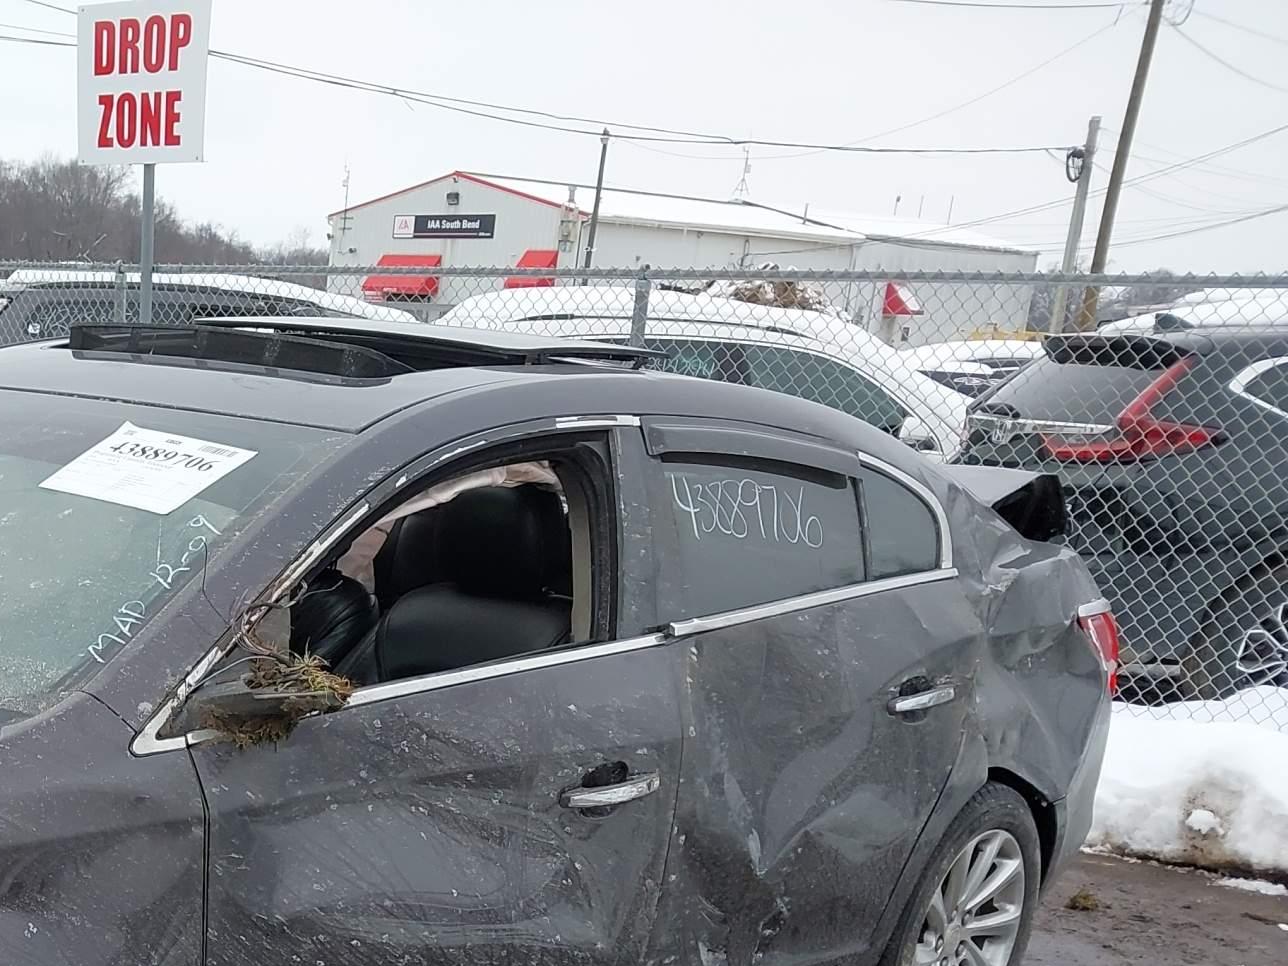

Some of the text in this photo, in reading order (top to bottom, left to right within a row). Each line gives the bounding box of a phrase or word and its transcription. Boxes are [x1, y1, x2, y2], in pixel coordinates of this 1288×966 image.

[93, 12, 192, 76] DROP
[97, 90, 182, 148] ZONE
[427, 219, 481, 229] IAA South Bend
[109, 441, 221, 471] 43889706
[87, 600, 146, 663] MAD
